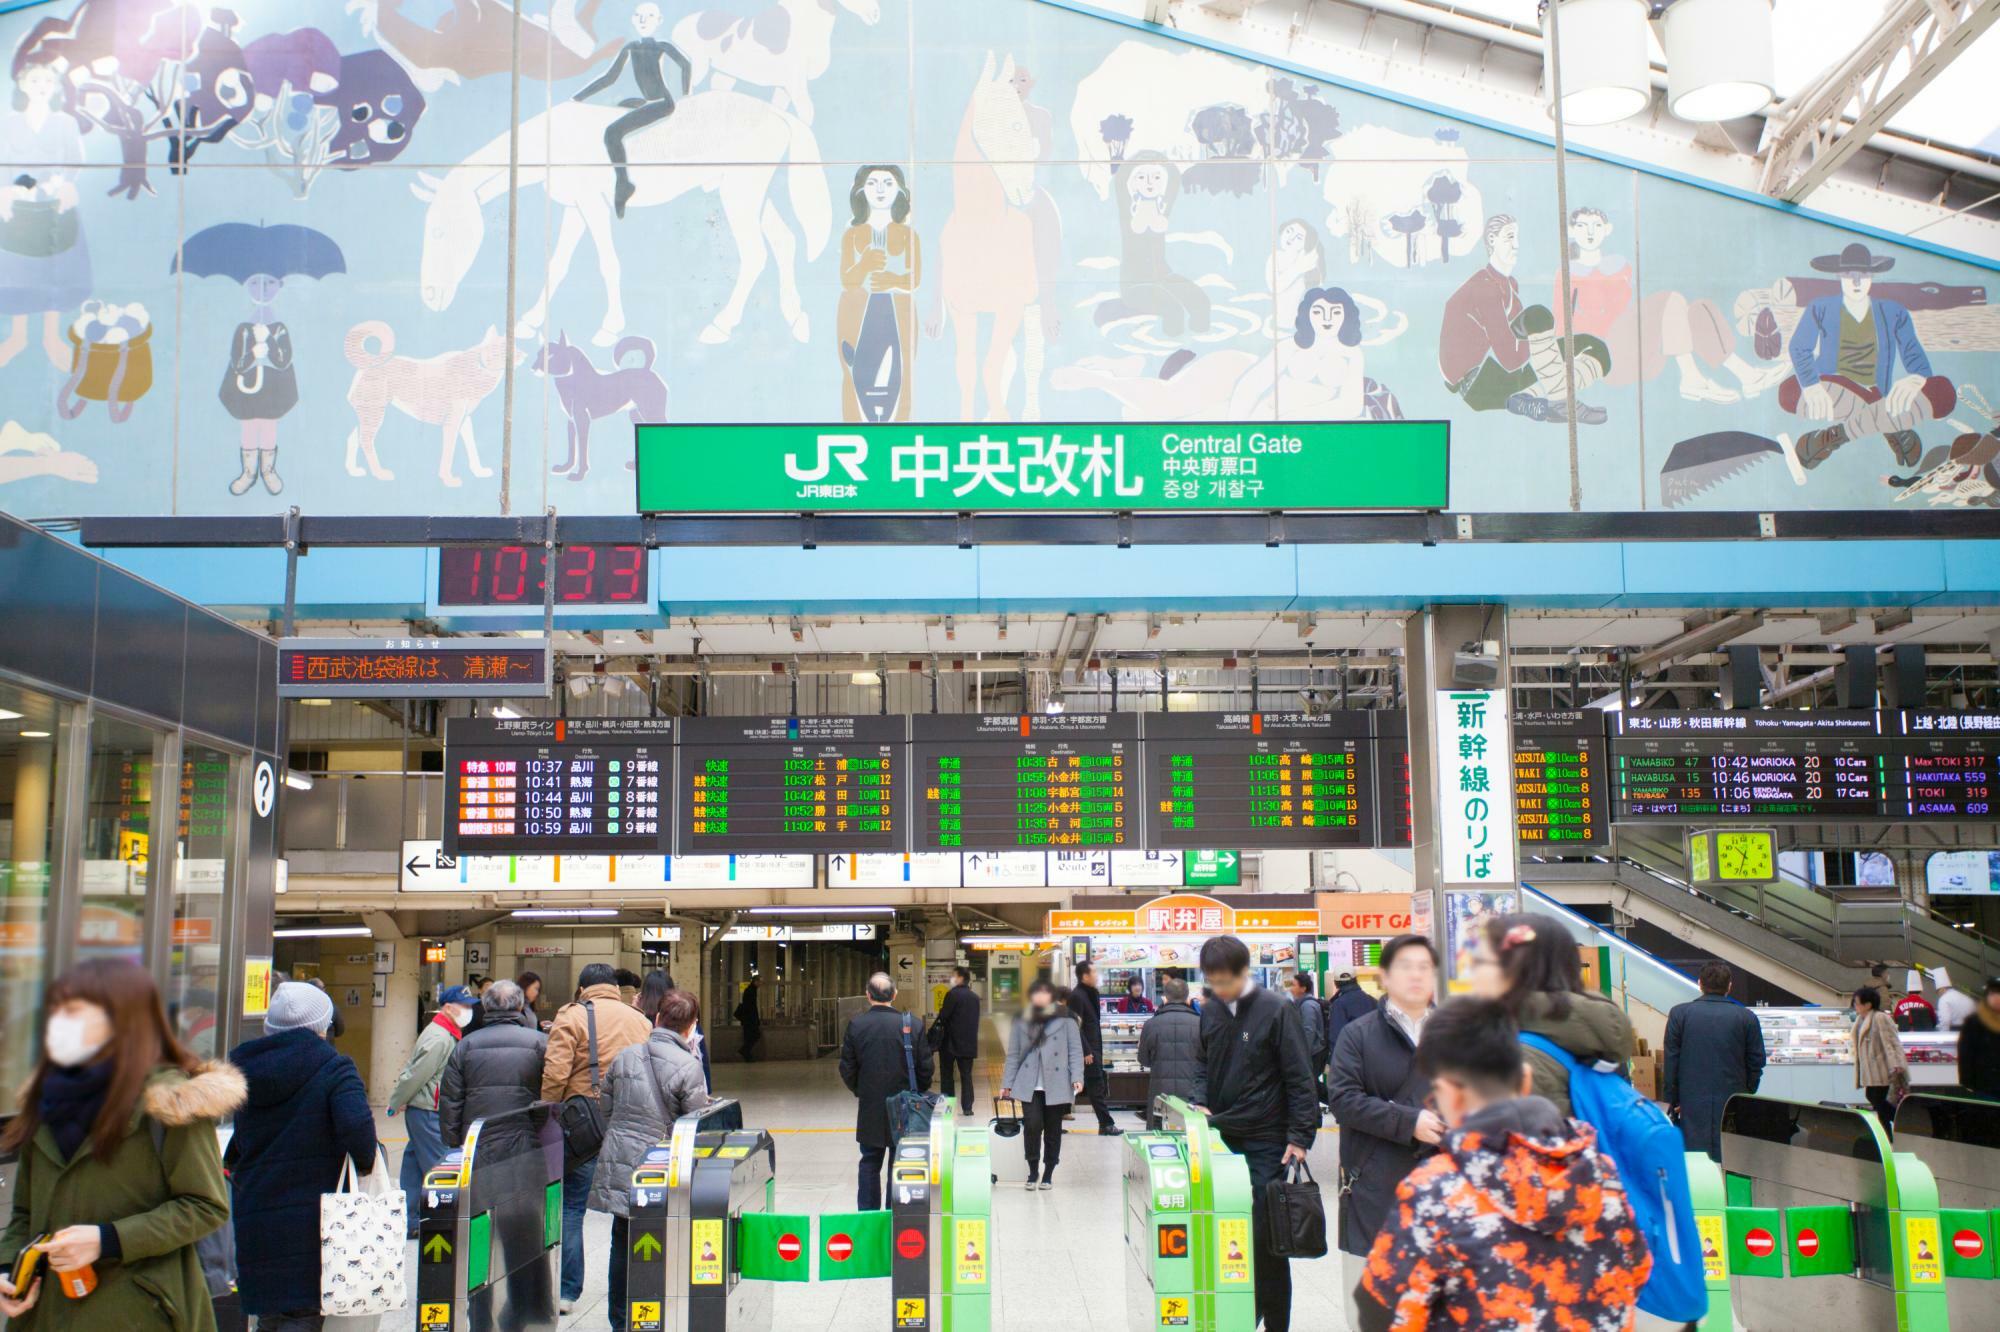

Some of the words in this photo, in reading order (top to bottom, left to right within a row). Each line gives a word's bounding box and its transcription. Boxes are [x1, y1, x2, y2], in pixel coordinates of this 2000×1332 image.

[1161, 433, 1242, 455] Central
[1248, 433, 1302, 455] Gate
[784, 434, 869, 482] JR
[891, 434, 1144, 498] 中央改札
[1162, 456, 1258, 477] 中央剪票口
[796, 484, 859, 499] JR東日本
[1162, 479, 1200, 499] 중앙
[1208, 479, 1265, 499] 개찰구
[468, 545, 642, 601] 10:33
[495, 721, 554, 731] 上野東京ライン
[1629, 718, 1747, 729] 東北・山形・秋田新幹線
[1782, 719, 1814, 728] Yamagata
[1817, 719, 1834, 727] Akita
[1114, 756, 1121, 766] 5
[1249, 755, 1279, 766] 10:45
[1347, 754, 1353, 763] 5
[1579, 753, 1587, 762] 8
[1630, 759, 1675, 767] YAMABIKO
[1684, 758, 1698, 767] 47
[1712, 757, 1748, 768] 10:42
[1750, 758, 1795, 767] MORIOKA
[1804, 757, 1819, 768] 20
[1834, 758, 1845, 767] 10
[1847, 759, 1866, 767] Cars
[1934, 758, 1960, 766] TOKI
[1964, 757, 1984, 766] 317
[467, 761, 489, 773] 特急
[525, 762, 562, 772] 10:37
[571, 761, 593, 773] 品川
[705, 759, 729, 772] 快速
[783, 760, 814, 770] 10:32
[882, 760, 889, 768] 6
[1047, 771, 1080, 783] 小金井
[1114, 772, 1122, 781] 5
[1347, 770, 1354, 779] 5
[1580, 768, 1588, 777] 8
[1631, 774, 1675, 782] HAYABUSA
[1687, 773, 1699, 782] 15
[1712, 772, 1749, 783] 10:46
[1751, 774, 1796, 782] MORIOKA
[1805, 772, 1820, 783] 20
[1835, 774, 1846, 782] 10
[1848, 774, 1867, 782] Cars
[1916, 773, 1960, 781] HAKUTAKA
[1964, 773, 1986, 782] 559
[525, 777, 562, 787] 10:41
[570, 776, 593, 788] 熱海
[705, 775, 729, 788] 快速
[783, 775, 814, 786] 10:37
[881, 775, 890, 784] 12
[1114, 787, 1123, 796] 14
[1250, 786, 1280, 796] 11:15
[1348, 785, 1355, 794] 5
[1456, 701, 1492, 879] 新幹線のりば
[1581, 783, 1589, 792] 8
[1681, 788, 1700, 798] 135
[1713, 787, 1750, 798] 11:06
[1806, 787, 1821, 798] 20
[1836, 789, 1847, 797] 17
[1849, 789, 1869, 797] Cars
[1917, 788, 1945, 796] TOKI
[1967, 788, 1987, 797] 319
[524, 792, 561, 803] 10:44
[570, 792, 592, 803] 品川
[705, 790, 729, 803] 快速
[783, 790, 814, 801] 10:42
[881, 790, 890, 799] 11
[1047, 802, 1080, 813] 小金井
[1115, 802, 1123, 811] 5
[1347, 800, 1357, 809] 13
[1581, 798, 1589, 808] 8
[1919, 804, 1956, 813] ASAMA
[1968, 804, 1988, 813] 609
[524, 807, 561, 818] 10:50
[569, 807, 592, 818] 熱海
[705, 805, 729, 818] 快速
[783, 805, 814, 816] 10:52
[882, 805, 889, 815] 9
[1115, 817, 1123, 827] 5
[1349, 815, 1356, 824] 5
[1583, 814, 1590, 823] 8
[524, 823, 561, 833] 10:59
[569, 822, 592, 834] 品川
[705, 821, 729, 834] 快速
[783, 821, 814, 831] 11:02
[881, 821, 891, 830] 12
[1047, 832, 1080, 844] 小金井
[1116, 833, 1123, 842] 5
[1583, 829, 1591, 838] 8
[1148, 909, 1222, 931] 駅弁屋
[1341, 914, 1384, 930] GIFT
[1155, 1168, 1186, 1188] IC
[1161, 1228, 1186, 1255] IC
